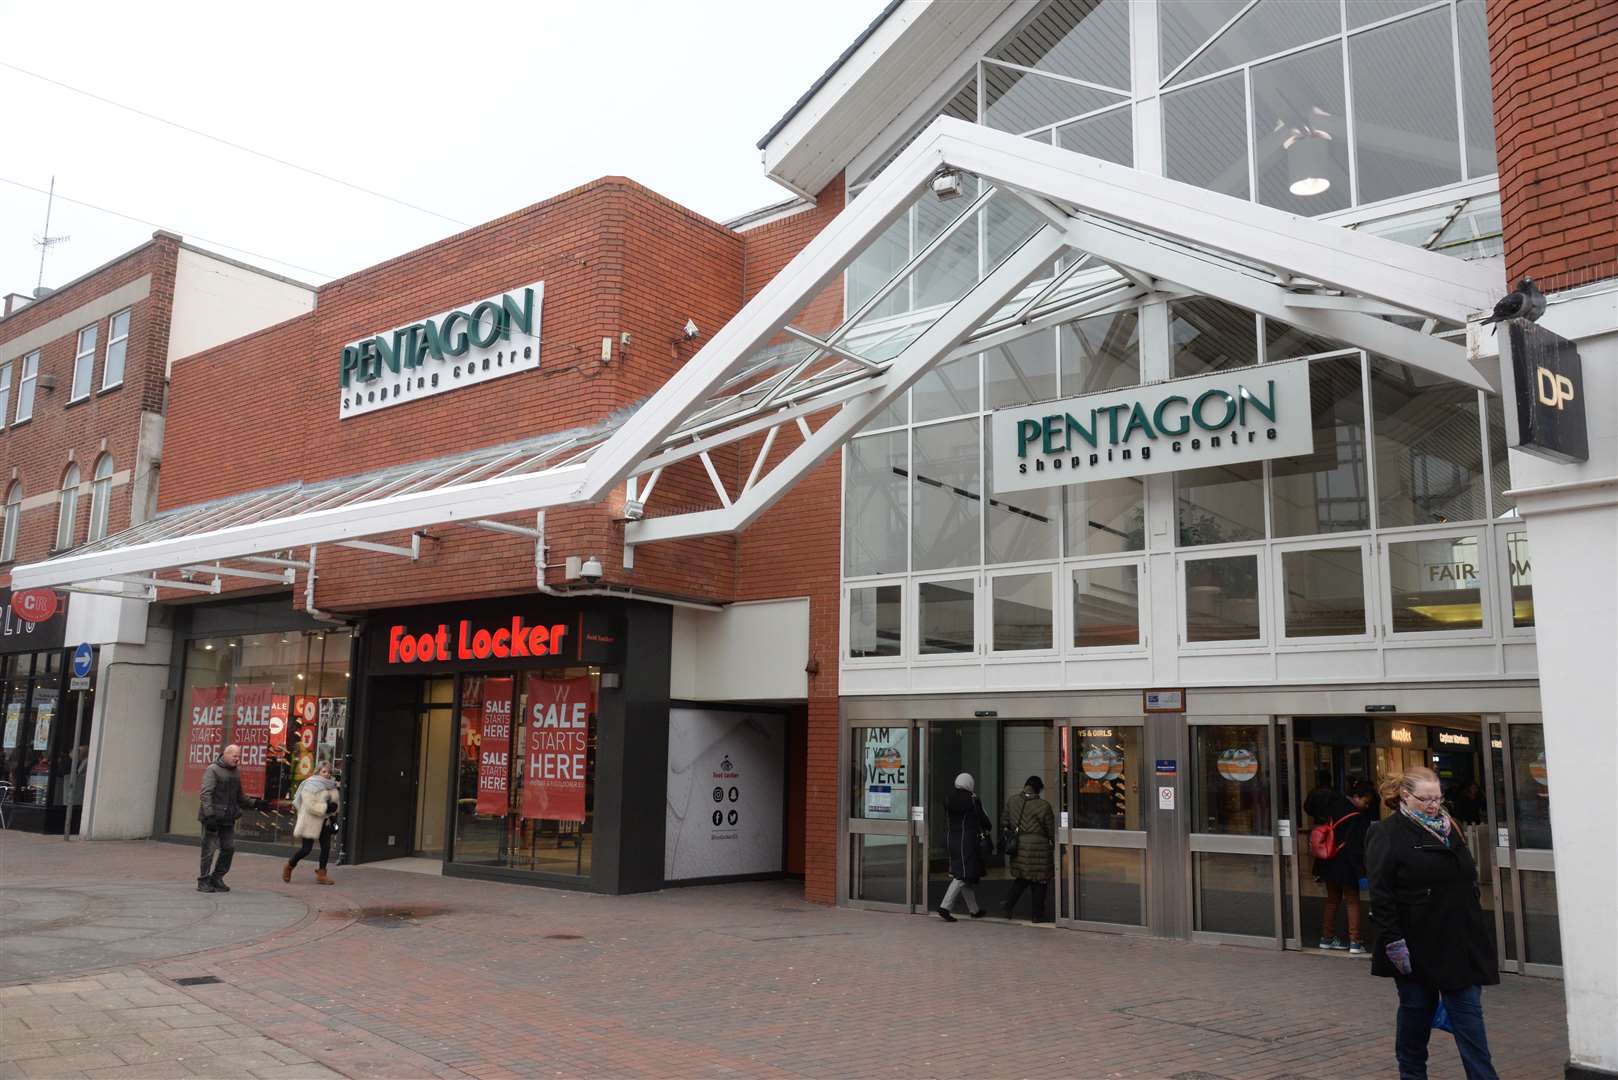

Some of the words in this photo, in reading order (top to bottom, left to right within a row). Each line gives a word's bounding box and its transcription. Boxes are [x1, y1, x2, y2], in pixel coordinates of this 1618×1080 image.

[339, 287, 534, 389] PENTAGON
[343, 371, 439, 409] shopping
[453, 345, 532, 378] centre
[1537, 366, 1574, 411] DP
[1016, 380, 1276, 458] PENTAGON
[1019, 445, 1151, 474] shopping
[1172, 426, 1277, 453] centre
[389, 624, 450, 664] Foot
[458, 616, 568, 660] Locker
[192, 705, 224, 725] SALE
[236, 705, 269, 726] SALE
[485, 700, 511, 713] SALE
[533, 702, 586, 728] SALE
[484, 714, 510, 725] STARTS
[191, 728, 223, 743] STARTS
[235, 728, 269, 743] STARTS
[483, 725, 509, 738] HERE
[531, 731, 585, 751] STARTS
[239, 745, 267, 765] ERE
[482, 752, 508, 765] SALE
[481, 765, 507, 777] STARTS
[530, 753, 585, 779] HERE
[480, 776, 506, 790] HERE
